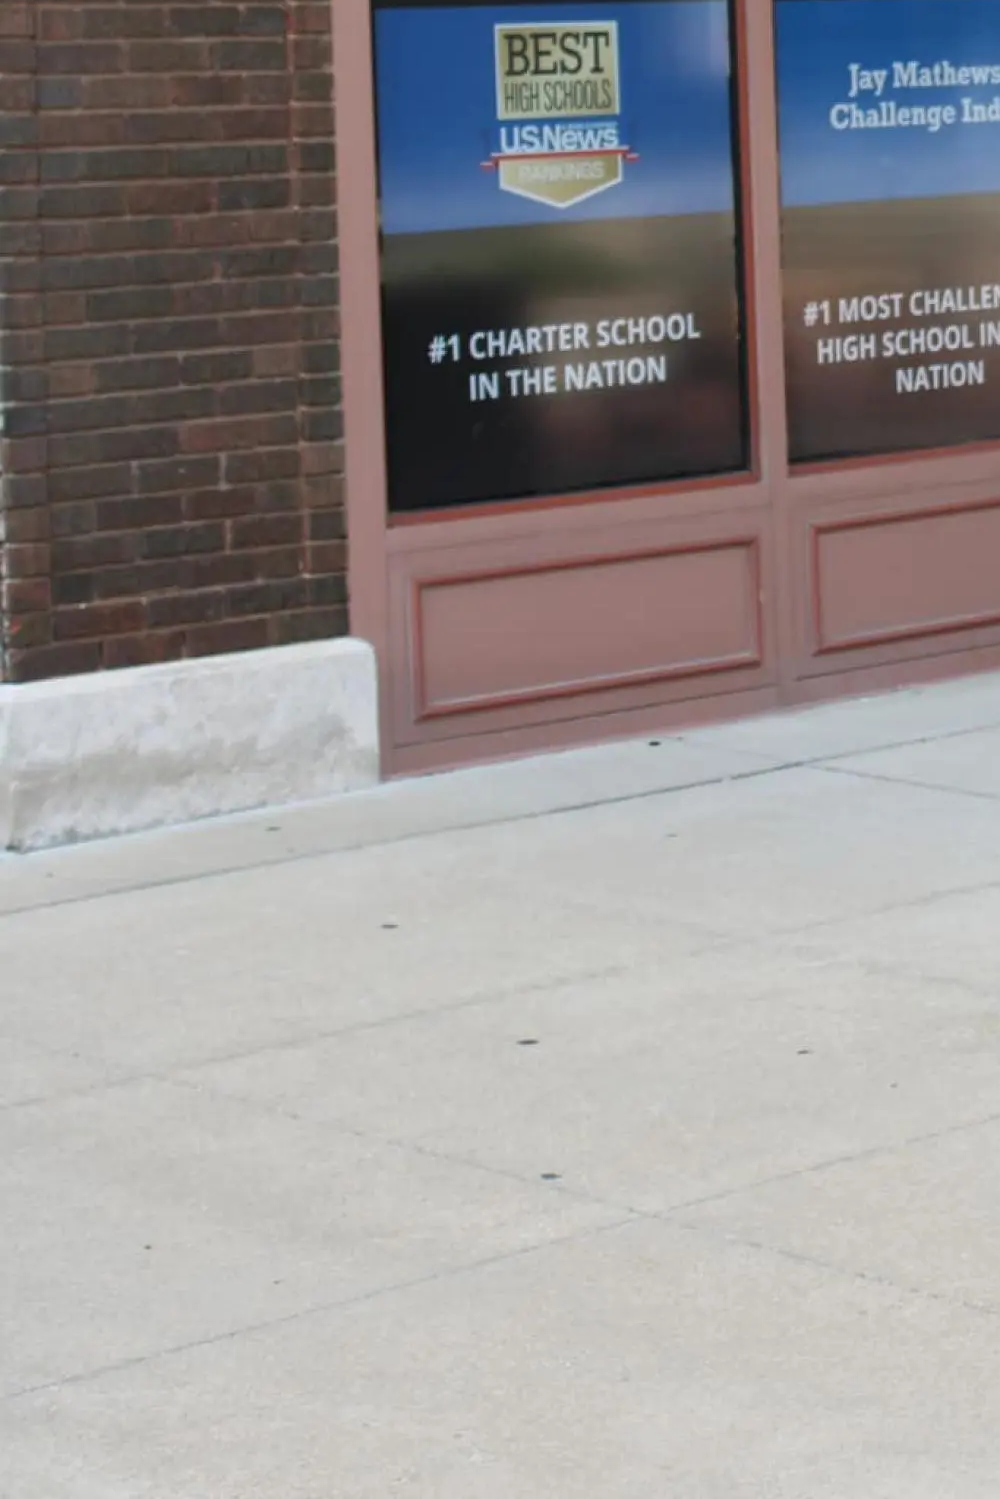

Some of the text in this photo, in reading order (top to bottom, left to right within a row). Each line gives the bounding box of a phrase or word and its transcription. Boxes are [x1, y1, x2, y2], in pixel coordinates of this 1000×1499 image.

[503, 31, 610, 76] BEST
[504, 78, 612, 113] HIGH SCHOOLS
[847, 62, 888, 97] Jay
[829, 100, 956, 132] Challenge
[803, 299, 832, 327] #1
[839, 293, 903, 323] MOST
[428, 312, 701, 364] #1 CHARTER SCHOOL
[817, 333, 876, 365] HIGH
[882, 325, 974, 357] SCHOOL
[468, 355, 667, 402] IN THE NATION
[896, 360, 985, 394] NATION
